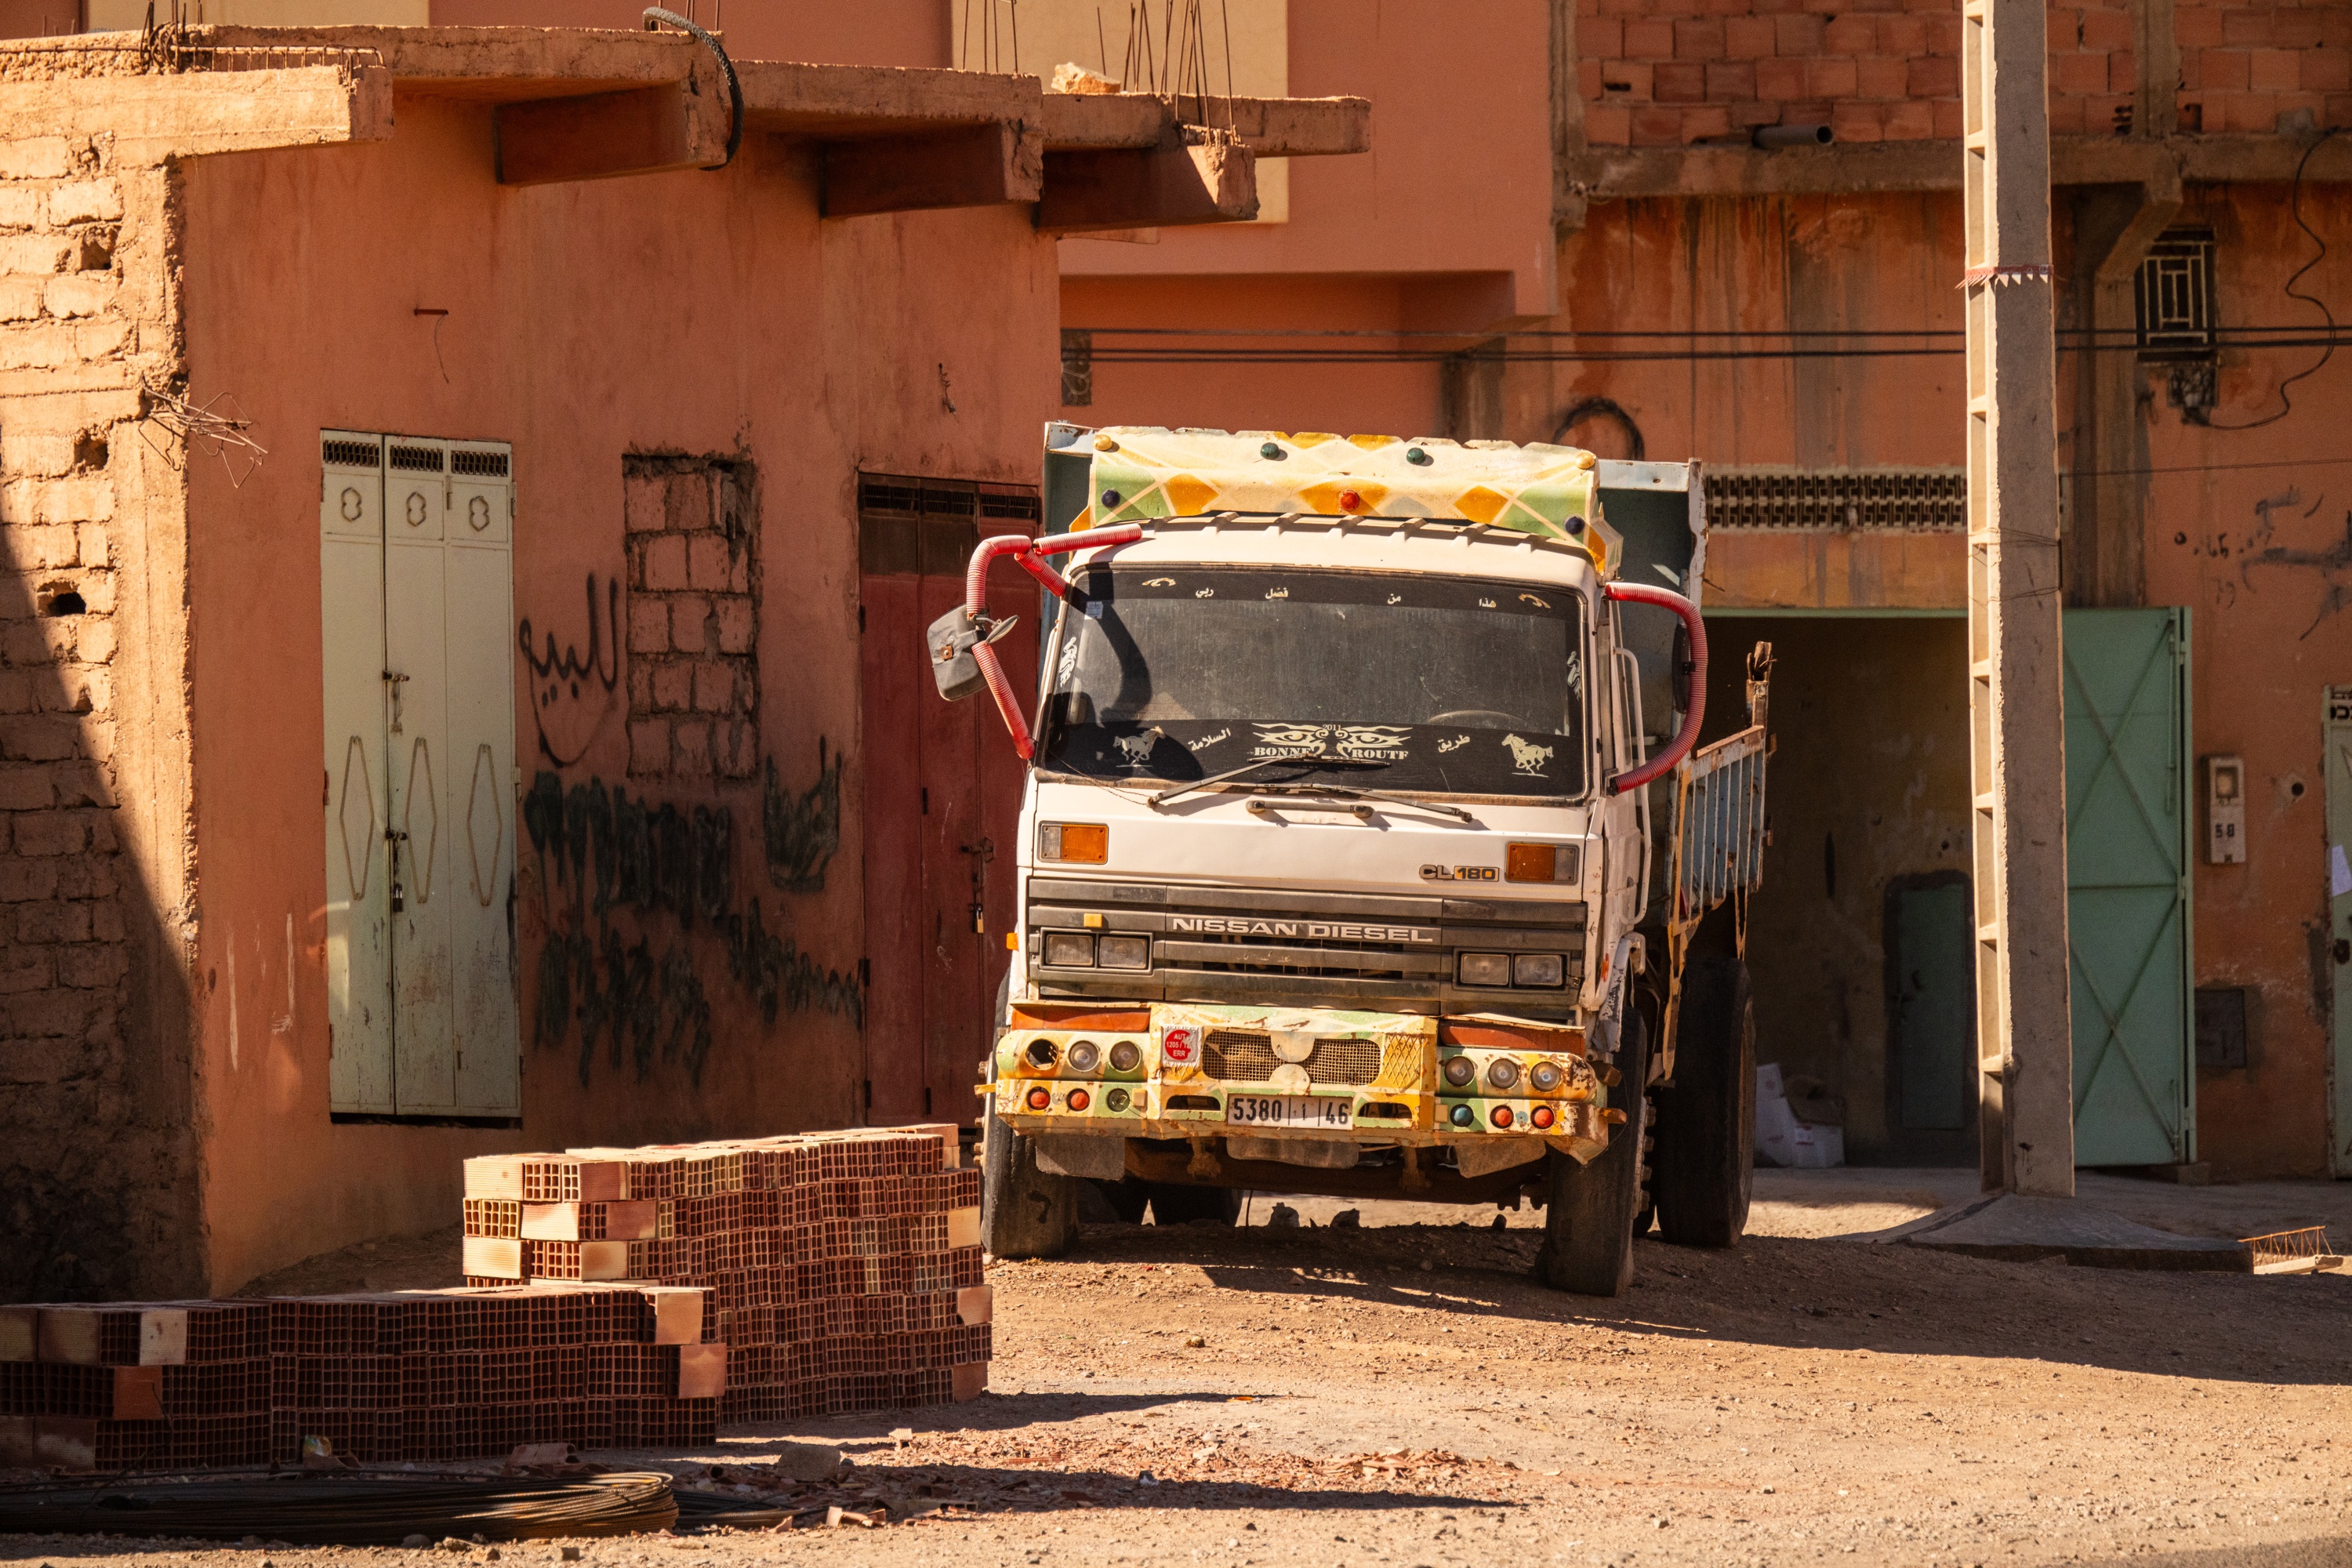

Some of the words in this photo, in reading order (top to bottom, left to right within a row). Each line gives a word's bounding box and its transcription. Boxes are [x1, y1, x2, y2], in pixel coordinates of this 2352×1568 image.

[1195, 587, 1214, 598] ربي
[1265, 587, 1289, 600] فضل
[1387, 593, 1402, 604] من
[1479, 597, 1497, 608] هذا
[1188, 728, 1232, 751] السلامة
[1437, 735, 1471, 753] طريق
[1418, 864, 1454, 880] CL
[1457, 867, 1496, 880] 180
[1172, 917, 1298, 936] NISSAN
[1308, 924, 1433, 942] DIESEL
[1233, 1098, 1282, 1122] 5380
[1325, 1102, 1349, 1125] 46
